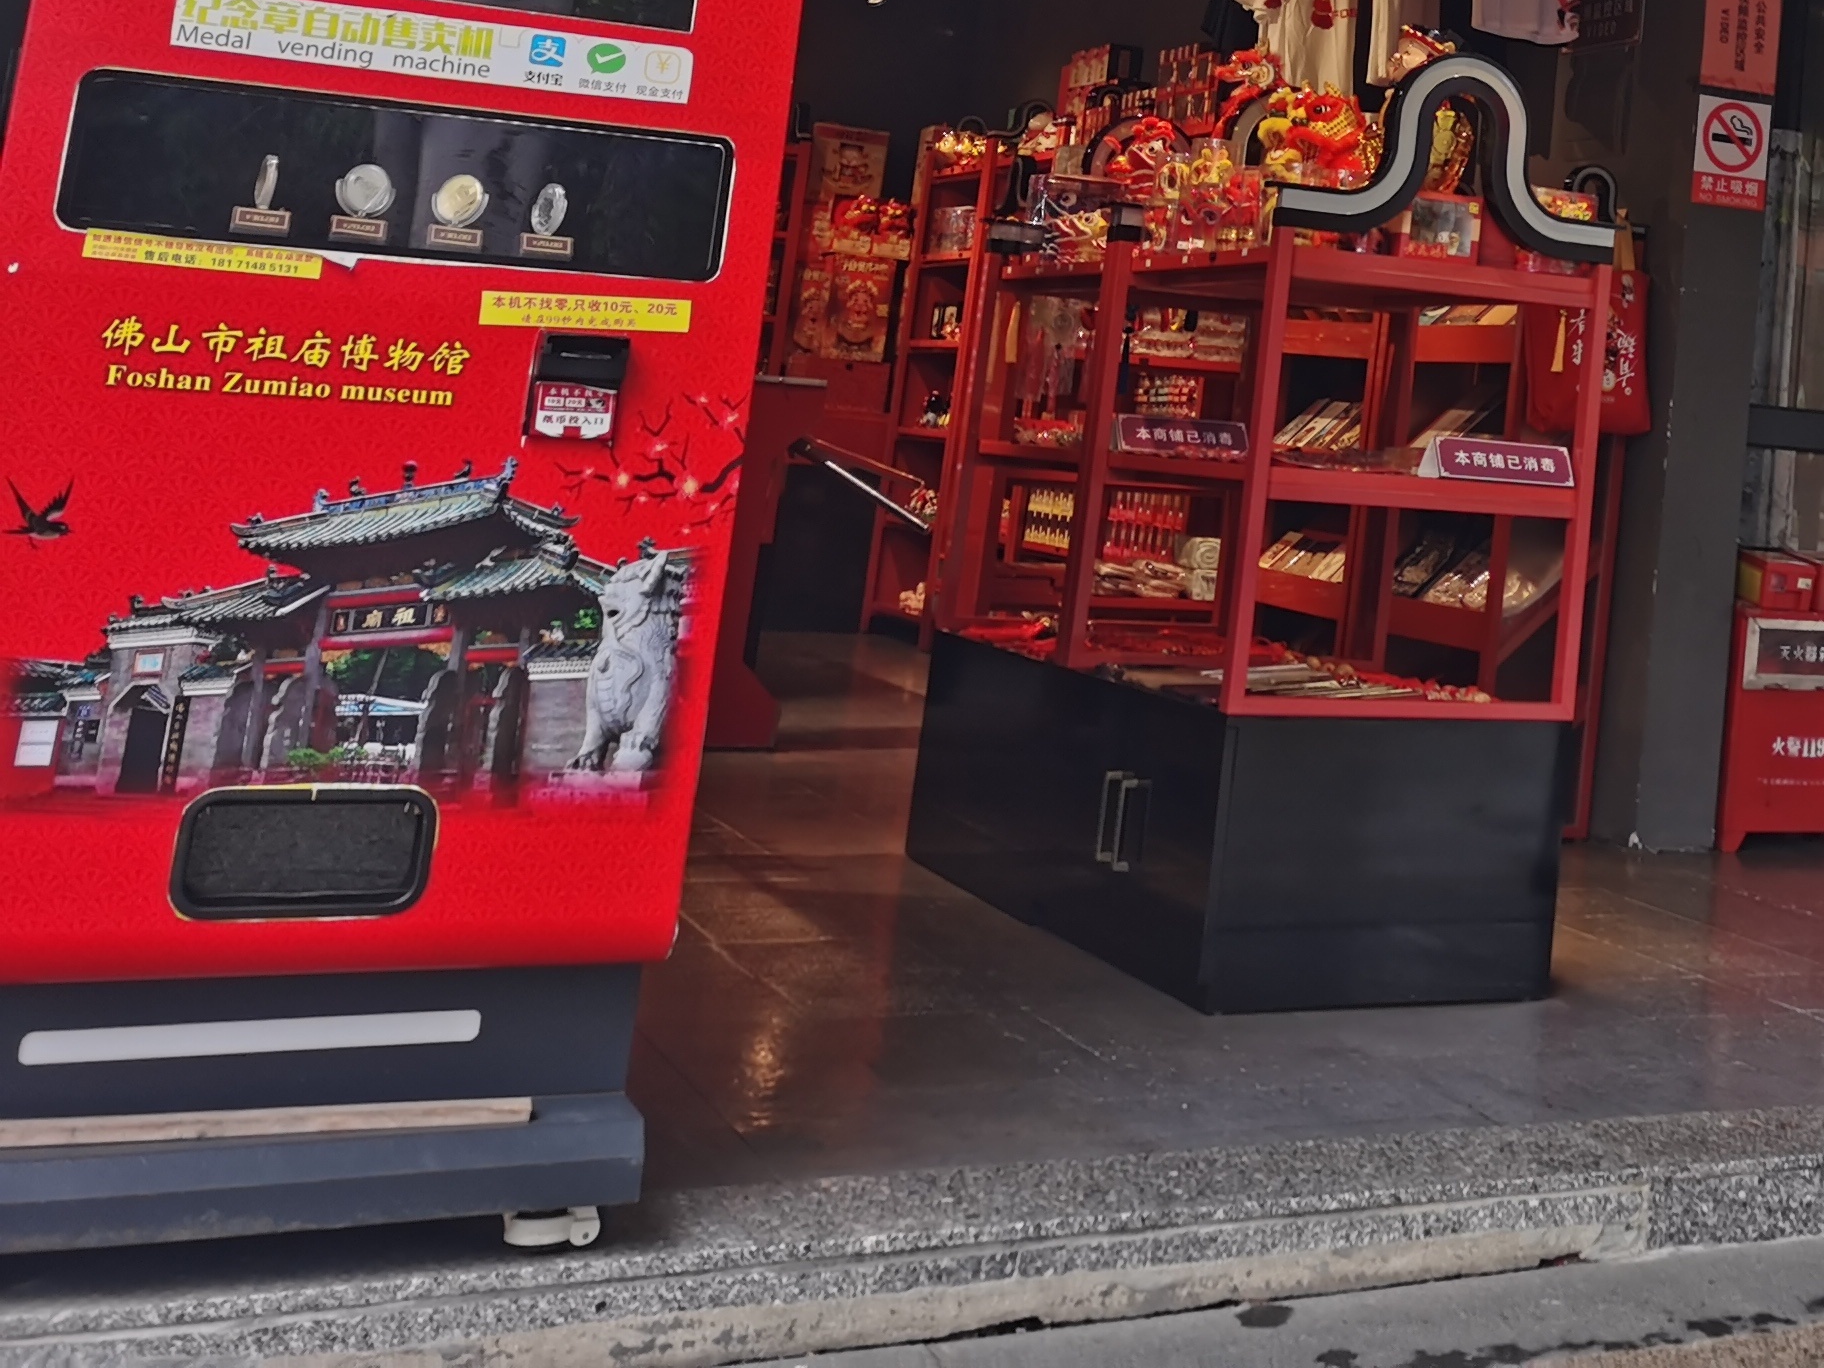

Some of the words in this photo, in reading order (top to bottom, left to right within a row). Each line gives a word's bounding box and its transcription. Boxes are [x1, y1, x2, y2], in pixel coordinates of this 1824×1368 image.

[176, 23, 252, 50] Medal
[277, 39, 374, 69] vending
[393, 53, 491, 78] machine
[1700, 174, 1759, 197] 禁止吸烟
[102, 315, 472, 376] 佛山市祖庙博物馆
[105, 363, 212, 392] Foshan
[222, 371, 332, 399] Zumiao
[340, 387, 454, 407] museum
[1135, 425, 1233, 447] 本商铺已消毒
[1453, 449, 1556, 474] 本商铺已消毒
